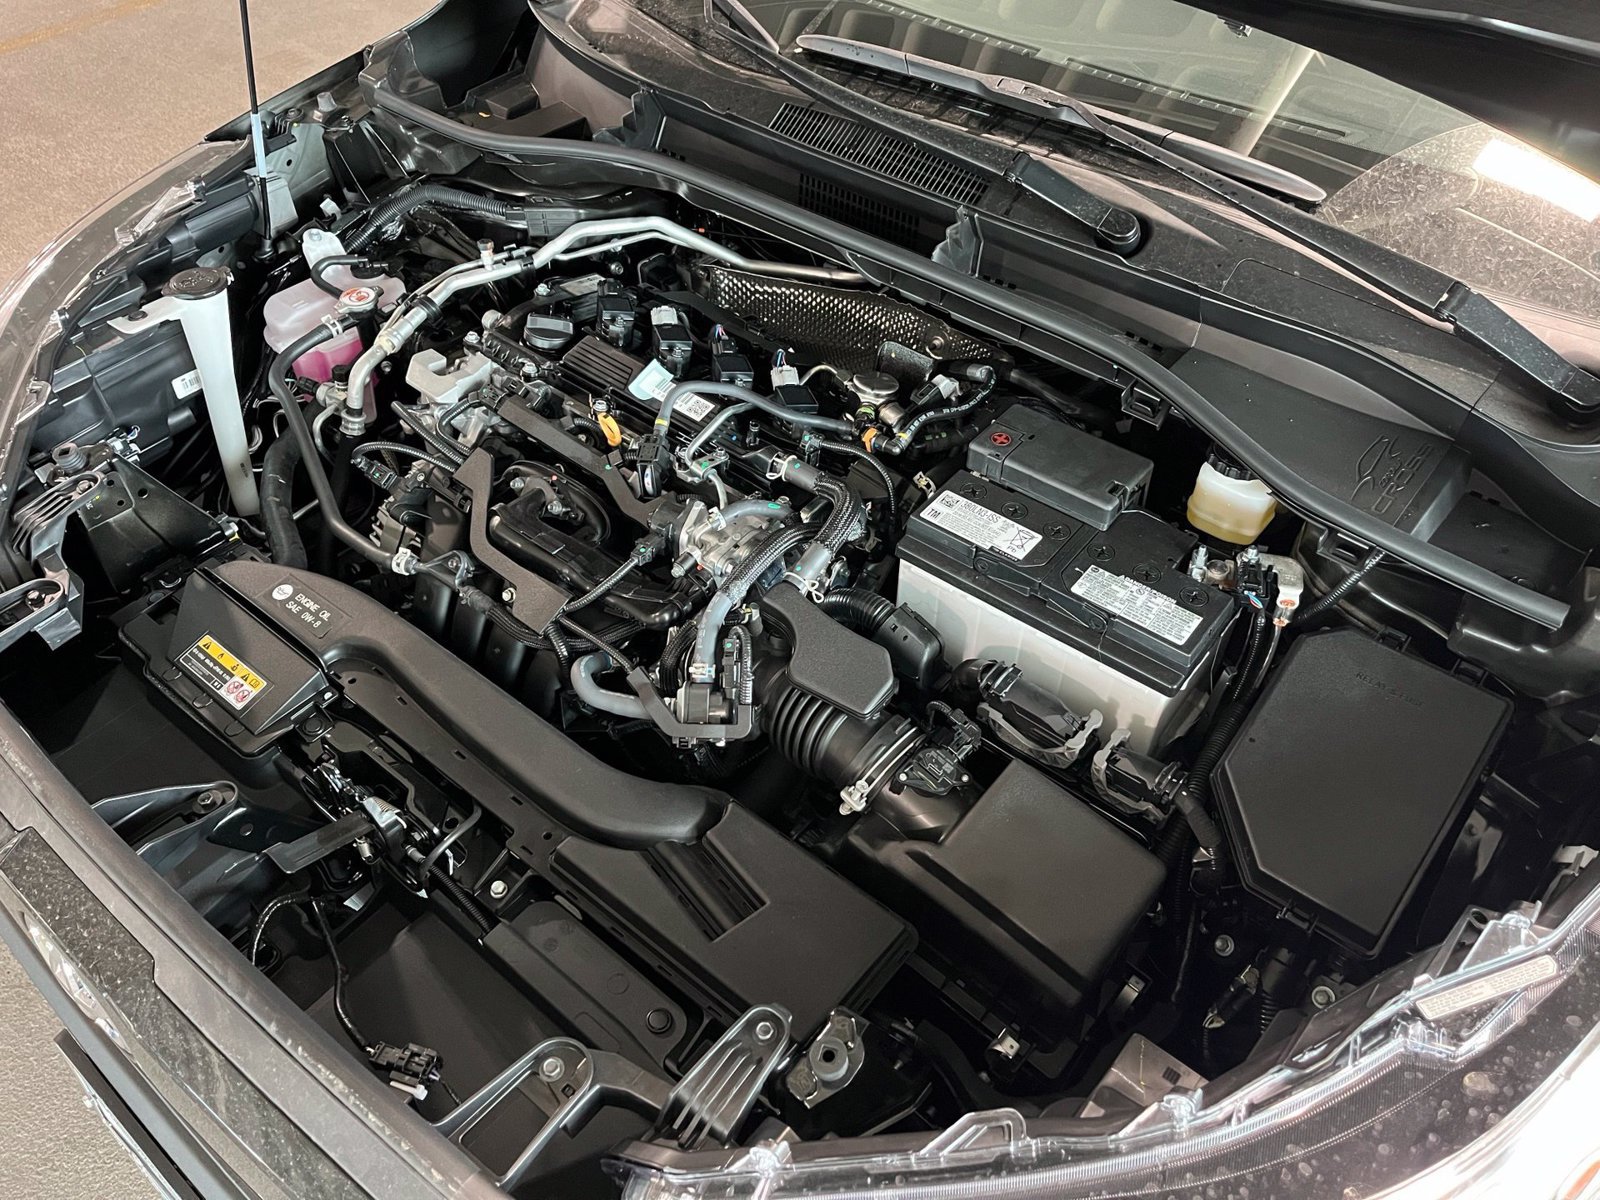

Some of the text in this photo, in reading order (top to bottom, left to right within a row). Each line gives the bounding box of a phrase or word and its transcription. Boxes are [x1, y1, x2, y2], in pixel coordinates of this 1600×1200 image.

[1371, 443, 1433, 514] CROSS
[927, 508, 941, 519] TM
[1007, 545, 1017, 554] Pb
[286, 601, 322, 628] SAE 0W-8
[295, 593, 331, 621] ENGINE OIL
